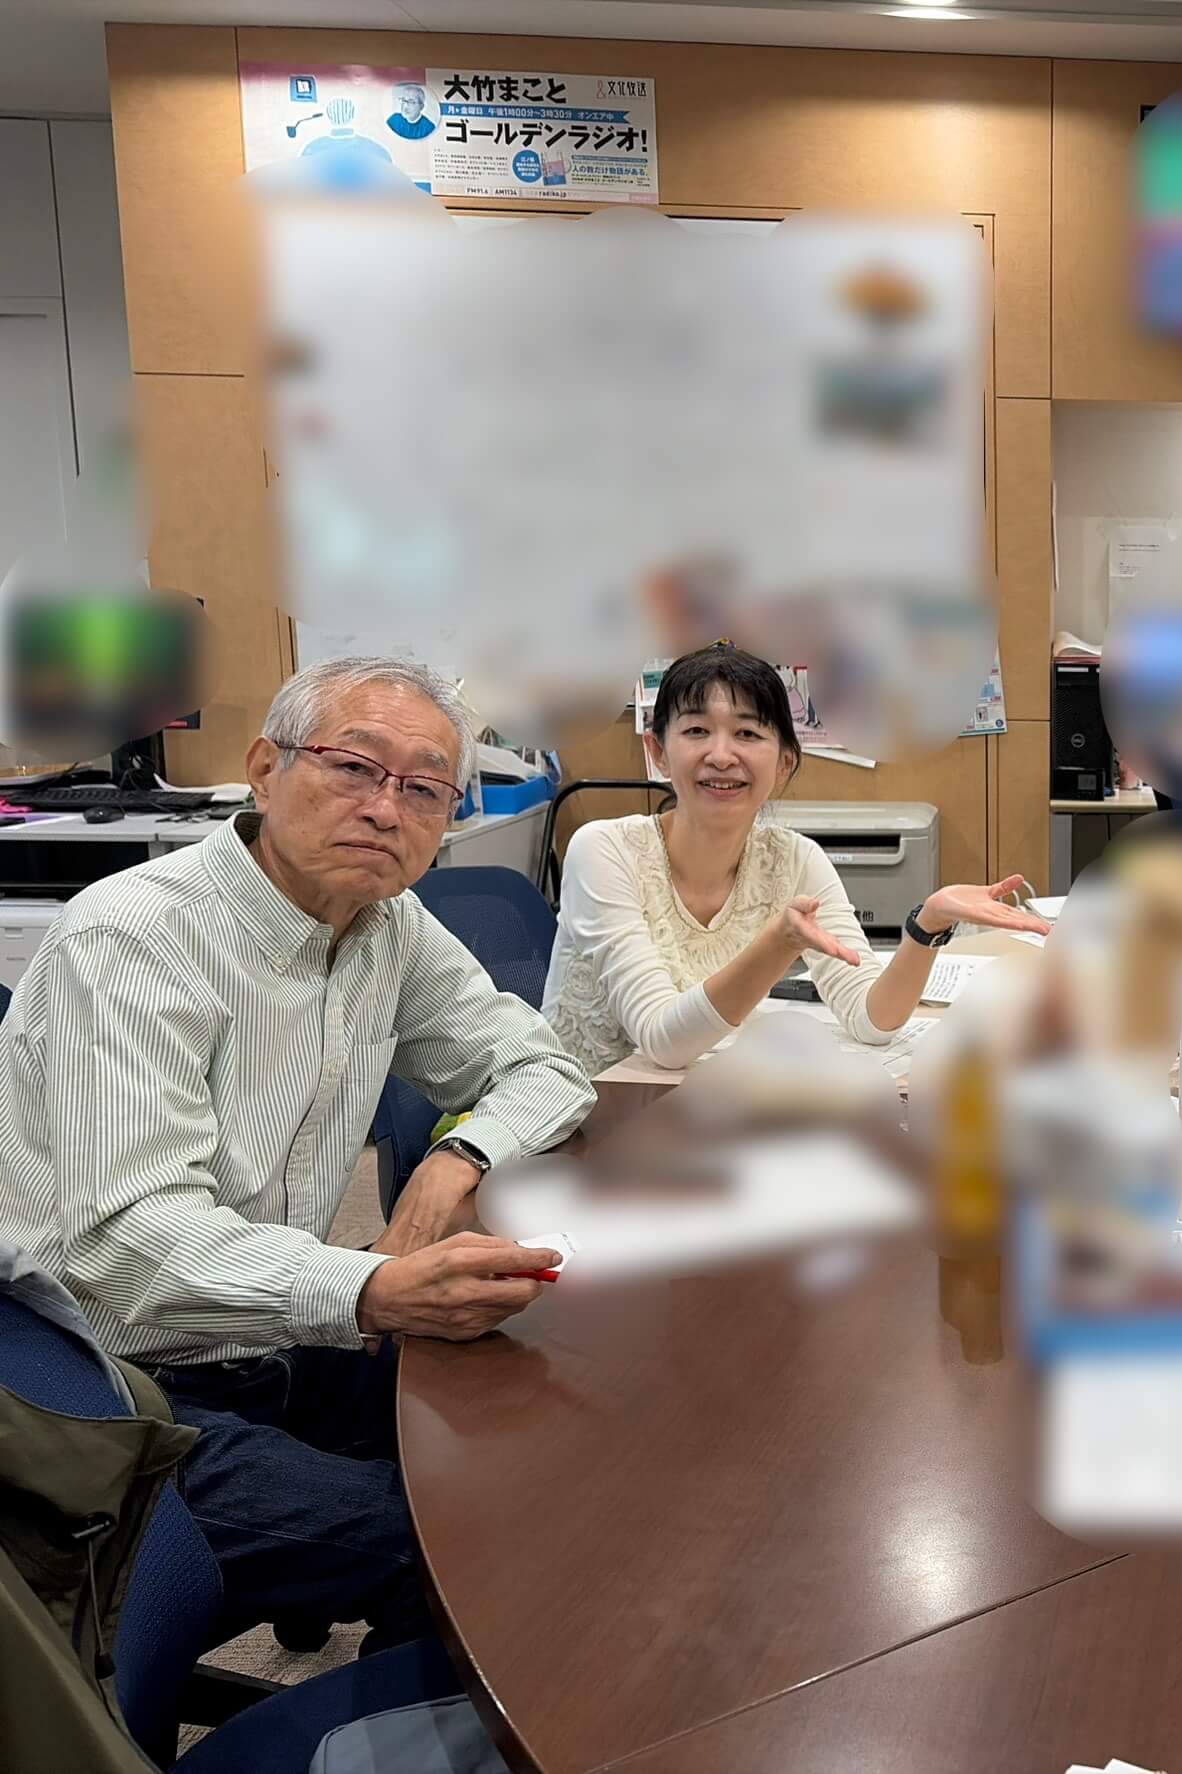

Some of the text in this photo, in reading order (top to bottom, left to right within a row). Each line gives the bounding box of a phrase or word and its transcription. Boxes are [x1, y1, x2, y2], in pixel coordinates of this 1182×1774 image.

[444, 74, 567, 103] 大竹まこと
[608, 81, 647, 97] 文化放送
[577, 112, 614, 121] オンエア中
[446, 118, 648, 152] ゴールデンラジオ!
